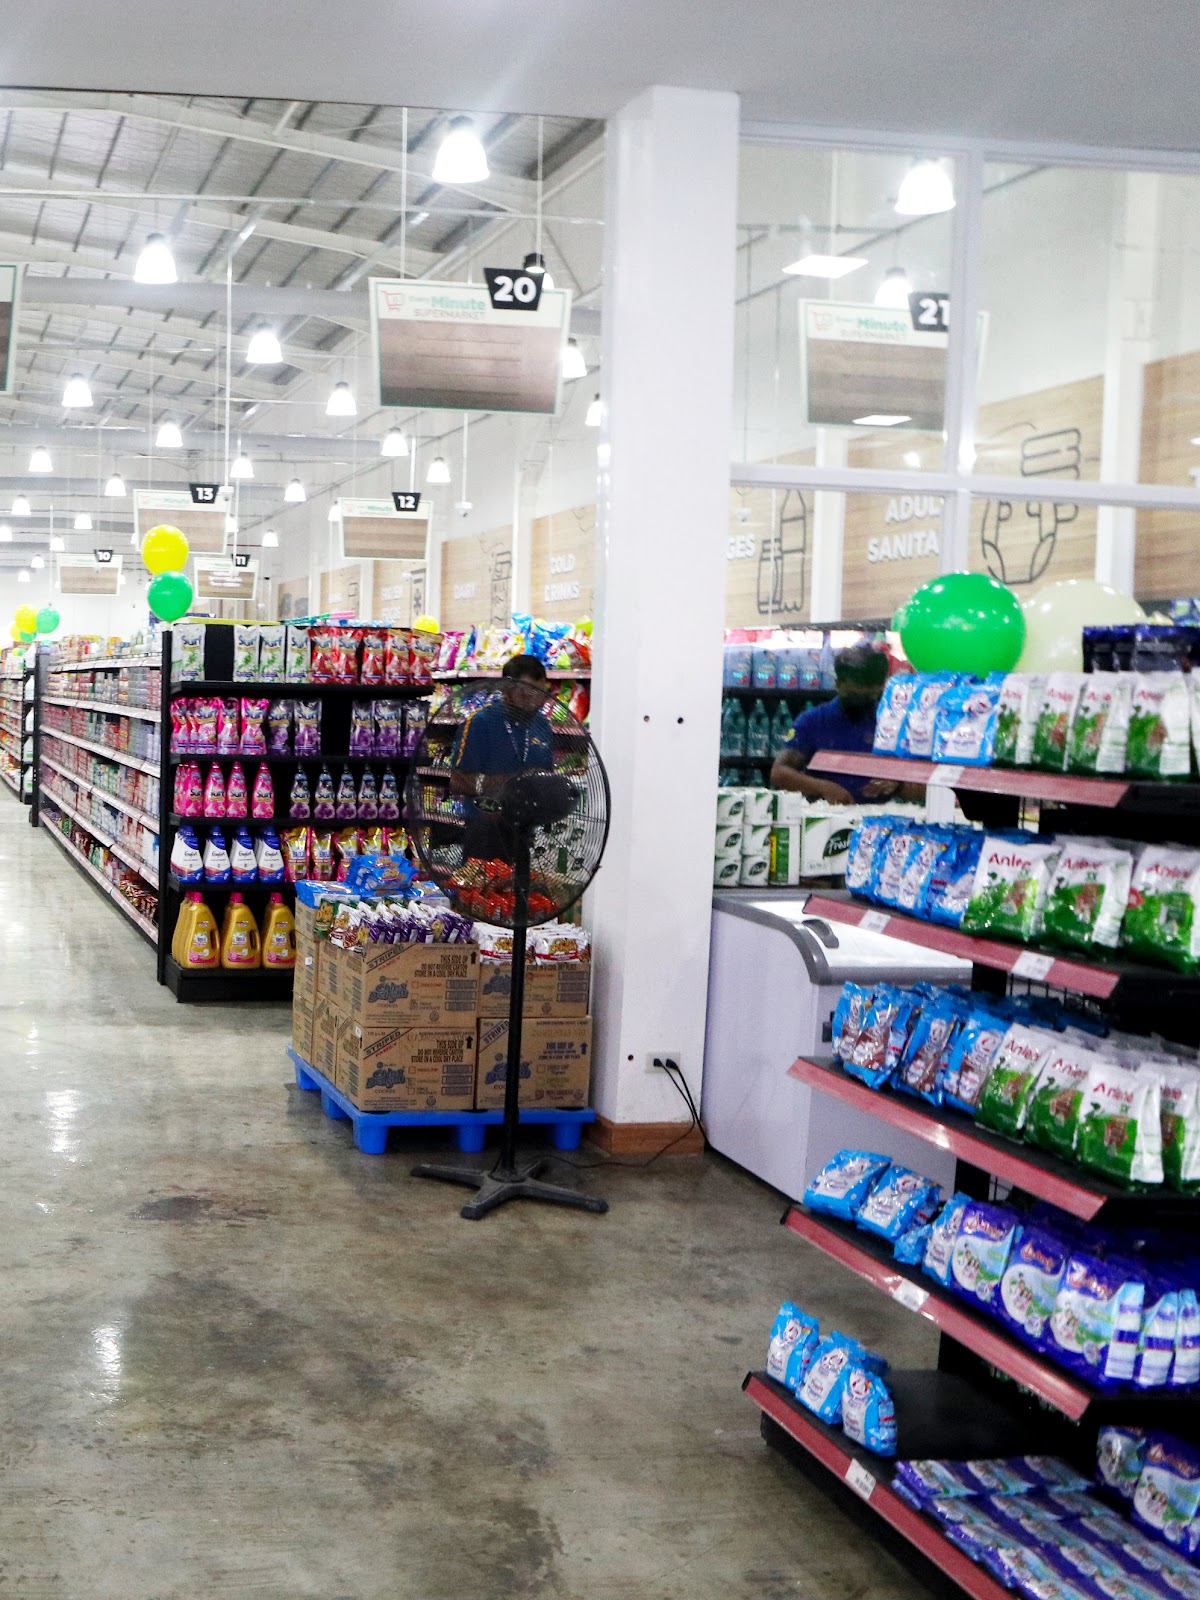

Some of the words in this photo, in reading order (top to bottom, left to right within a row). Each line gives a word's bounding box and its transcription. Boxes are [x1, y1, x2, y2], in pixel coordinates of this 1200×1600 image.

[494, 276, 536, 303] 20
[432, 295, 487, 311] Minute
[414, 308, 487, 320] SUPERMARKET
[918, 298, 950, 327] 21
[196, 487, 214, 500] 13
[398, 495, 416, 509] 12
[885, 495, 944, 524] ADUL
[99, 551, 111, 561] 10
[365, 1030, 401, 1056] STRIPED
